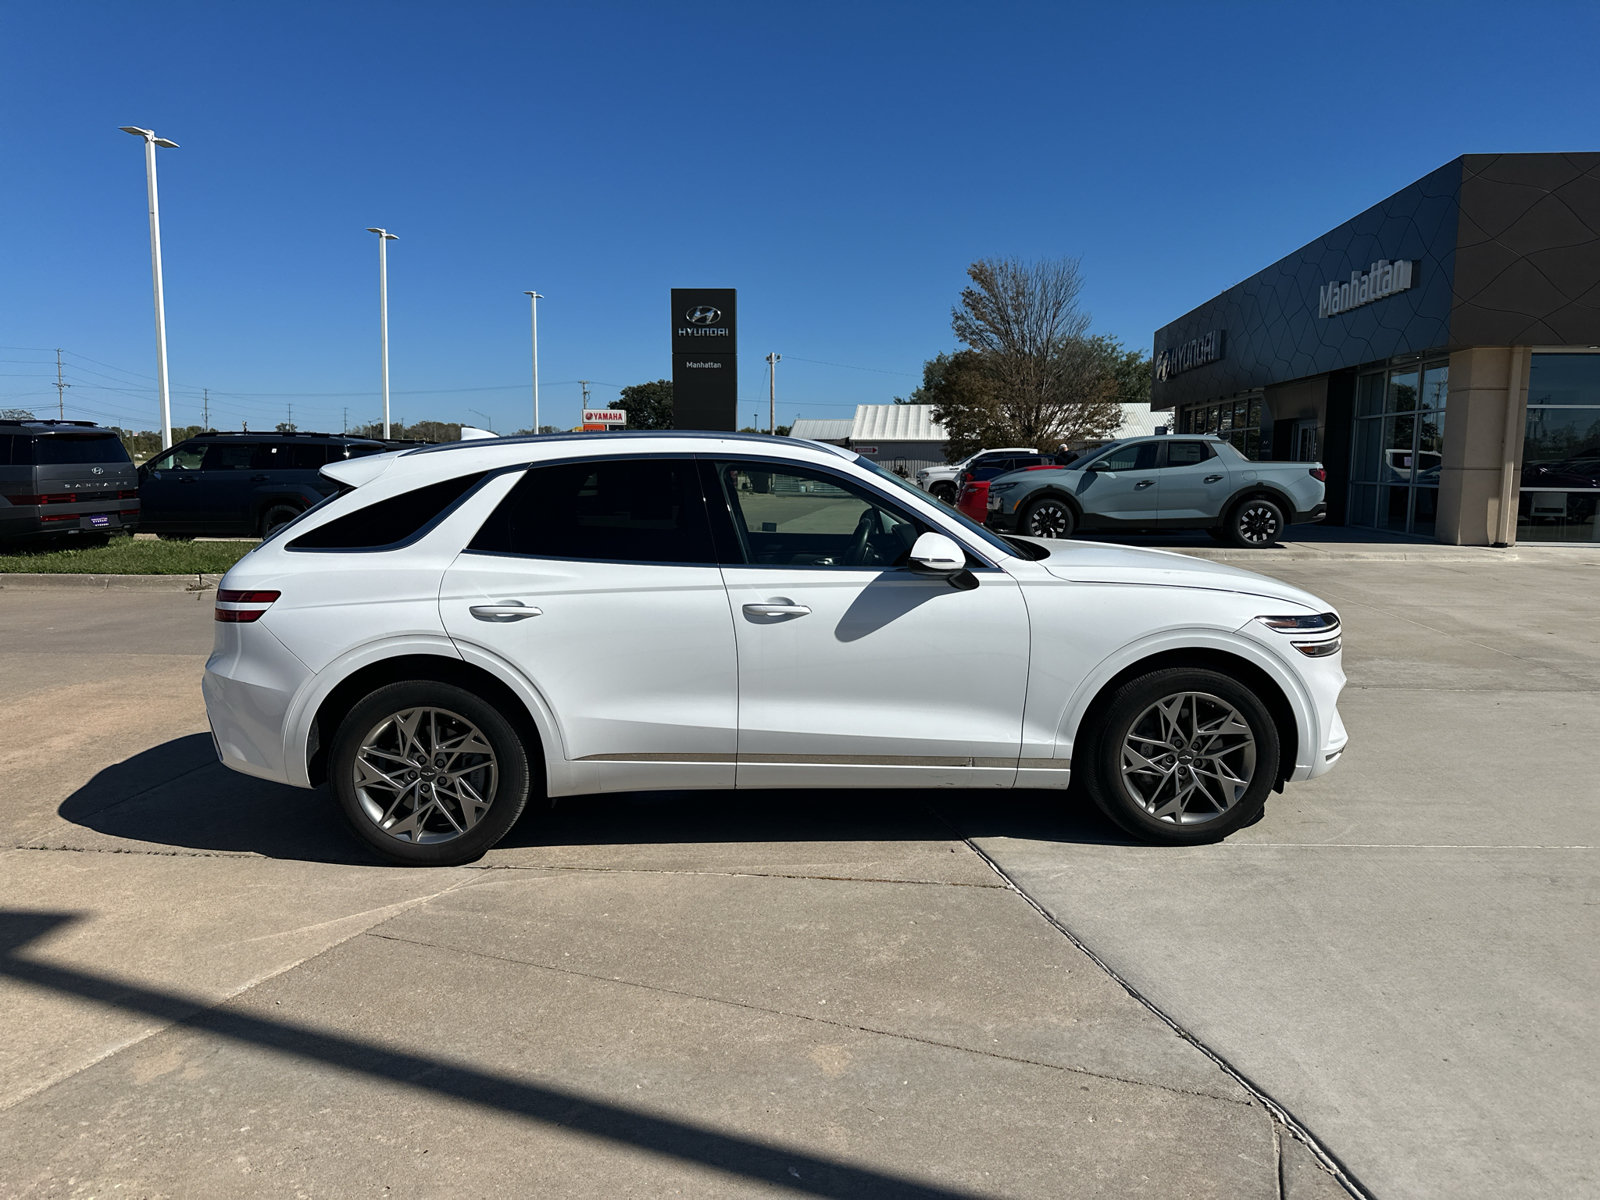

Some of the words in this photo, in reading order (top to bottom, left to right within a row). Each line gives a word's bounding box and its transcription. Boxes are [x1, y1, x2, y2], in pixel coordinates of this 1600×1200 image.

[1319, 259, 1411, 318] Manhattan
[678, 328, 729, 337] HYUNDAI
[1171, 330, 1219, 375] HYUNDAI
[686, 361, 722, 369] Manhattan
[593, 412, 623, 421] YAMAHA
